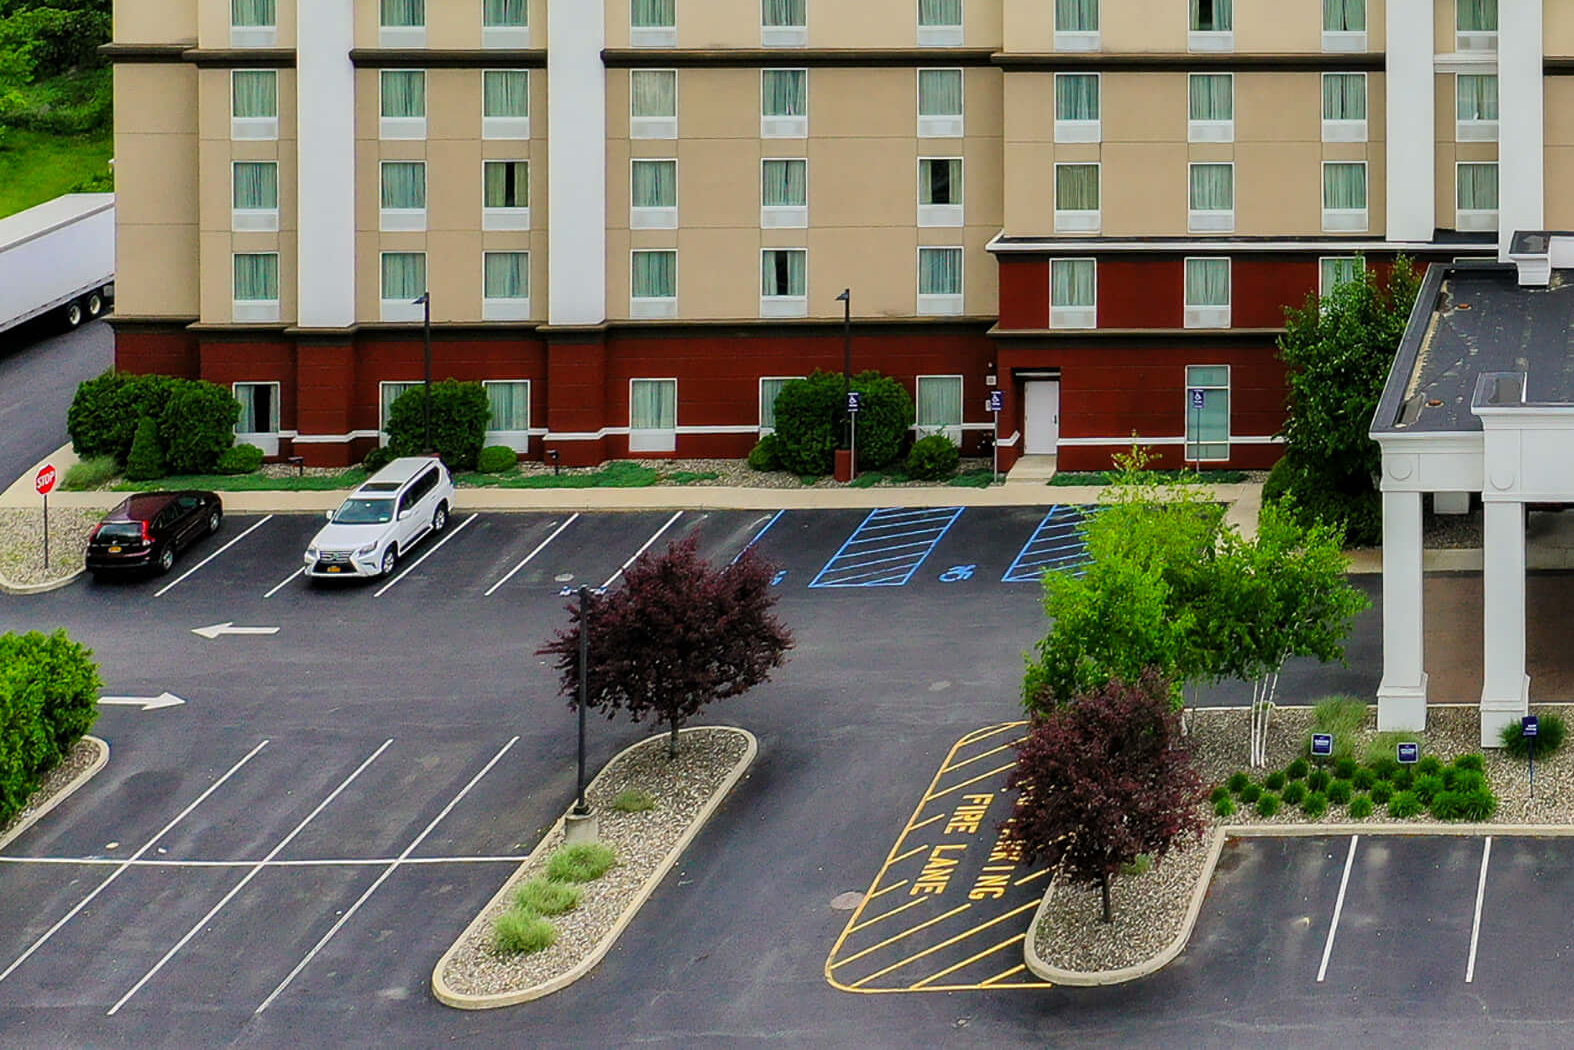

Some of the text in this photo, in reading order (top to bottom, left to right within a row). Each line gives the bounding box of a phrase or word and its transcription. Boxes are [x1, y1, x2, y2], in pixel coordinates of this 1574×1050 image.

[37, 470, 56, 489] STOP
[909, 793, 995, 896] FIRE LANE
